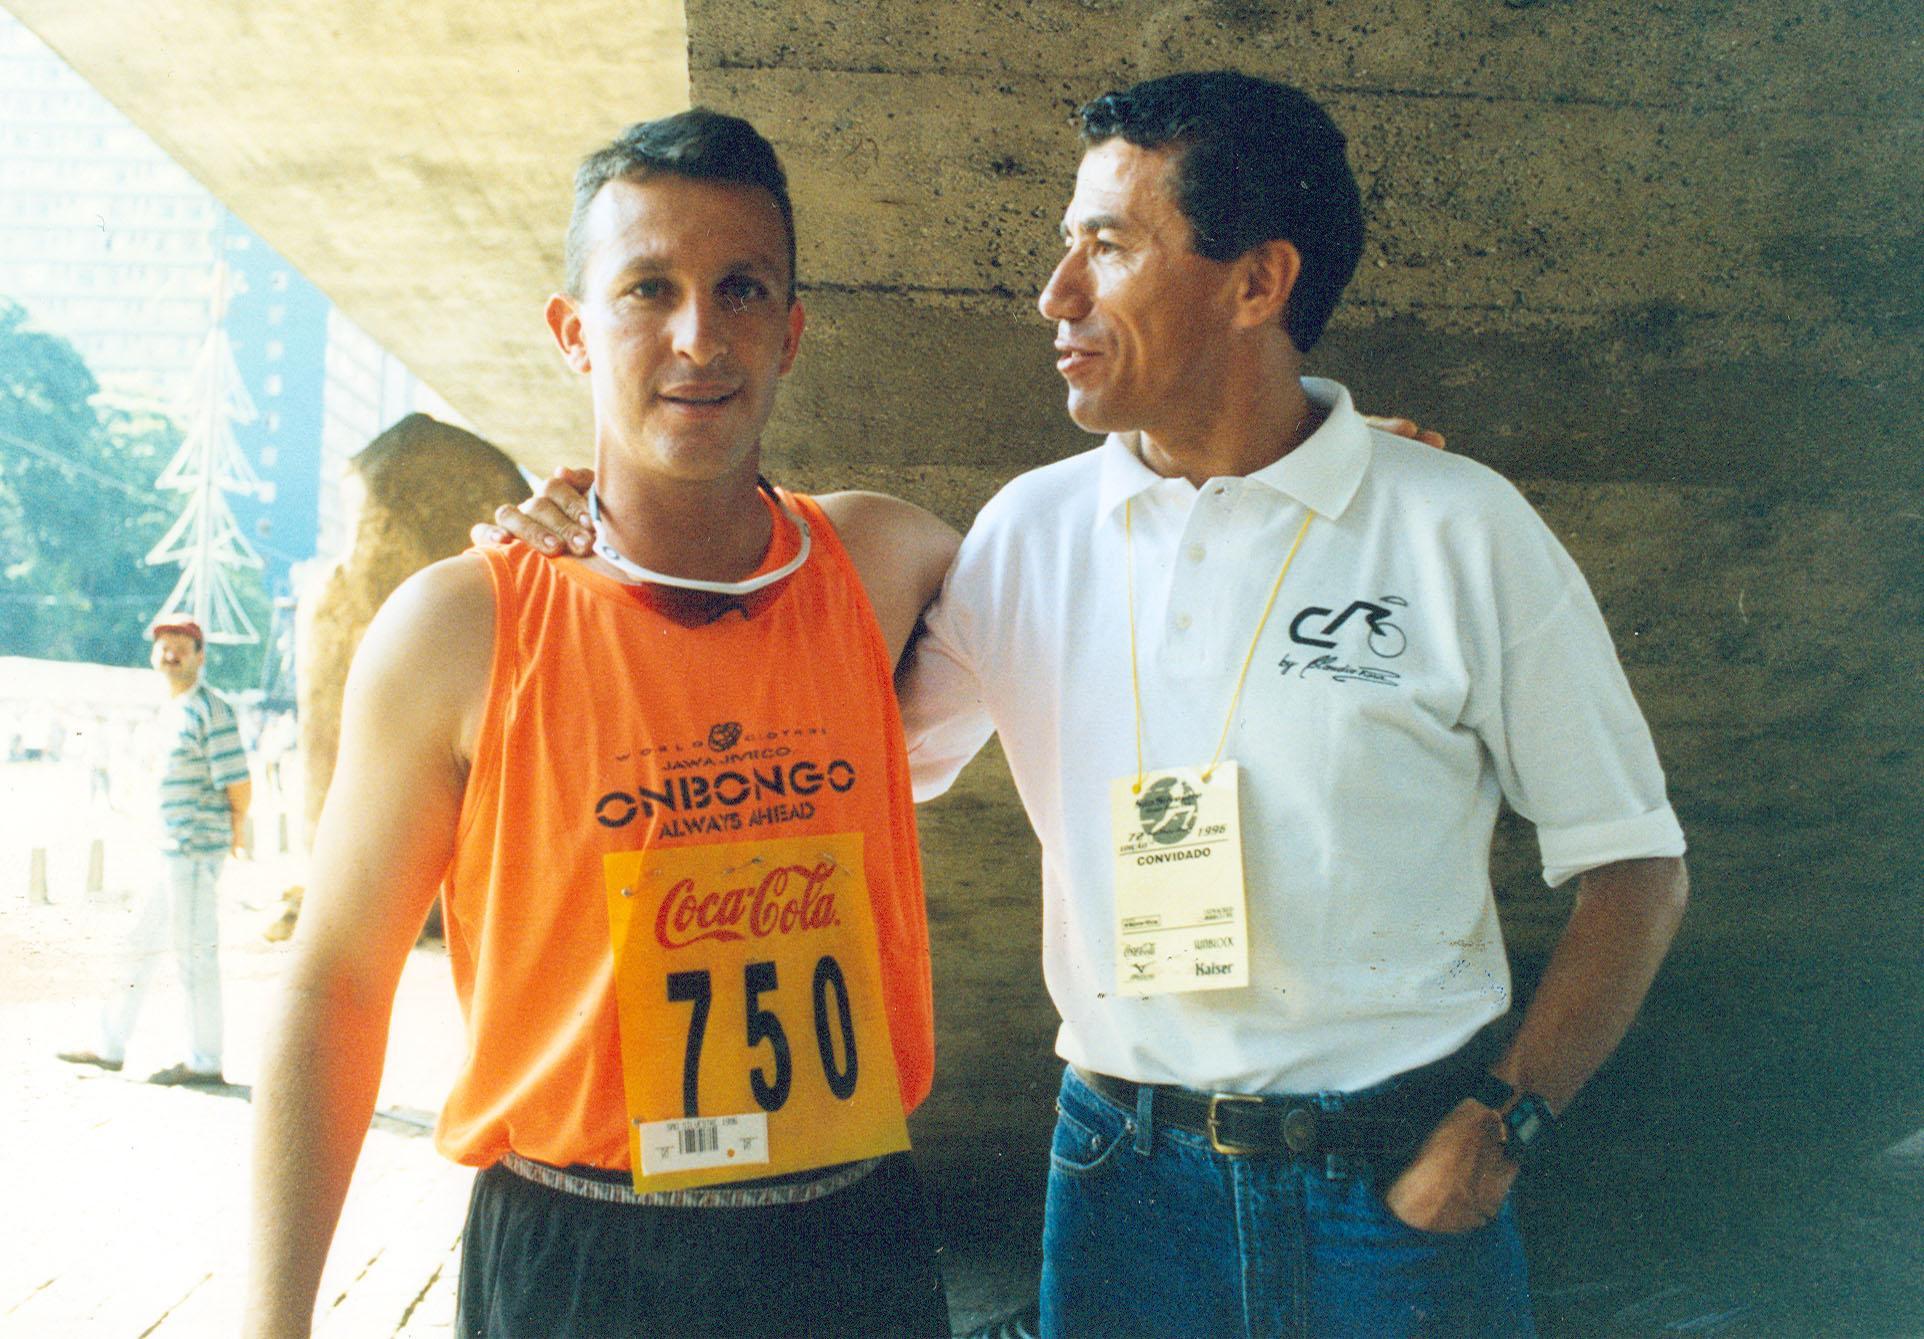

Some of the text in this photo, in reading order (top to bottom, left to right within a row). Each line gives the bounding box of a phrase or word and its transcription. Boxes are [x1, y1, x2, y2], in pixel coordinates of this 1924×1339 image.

[595, 758, 857, 828] ONBONGO
[659, 802, 816, 840] ALWAYS AHEAD
[1137, 847, 1211, 866] CONVIDADO
[1195, 961, 1233, 977] Kaiser
[666, 954, 858, 1118] 750
